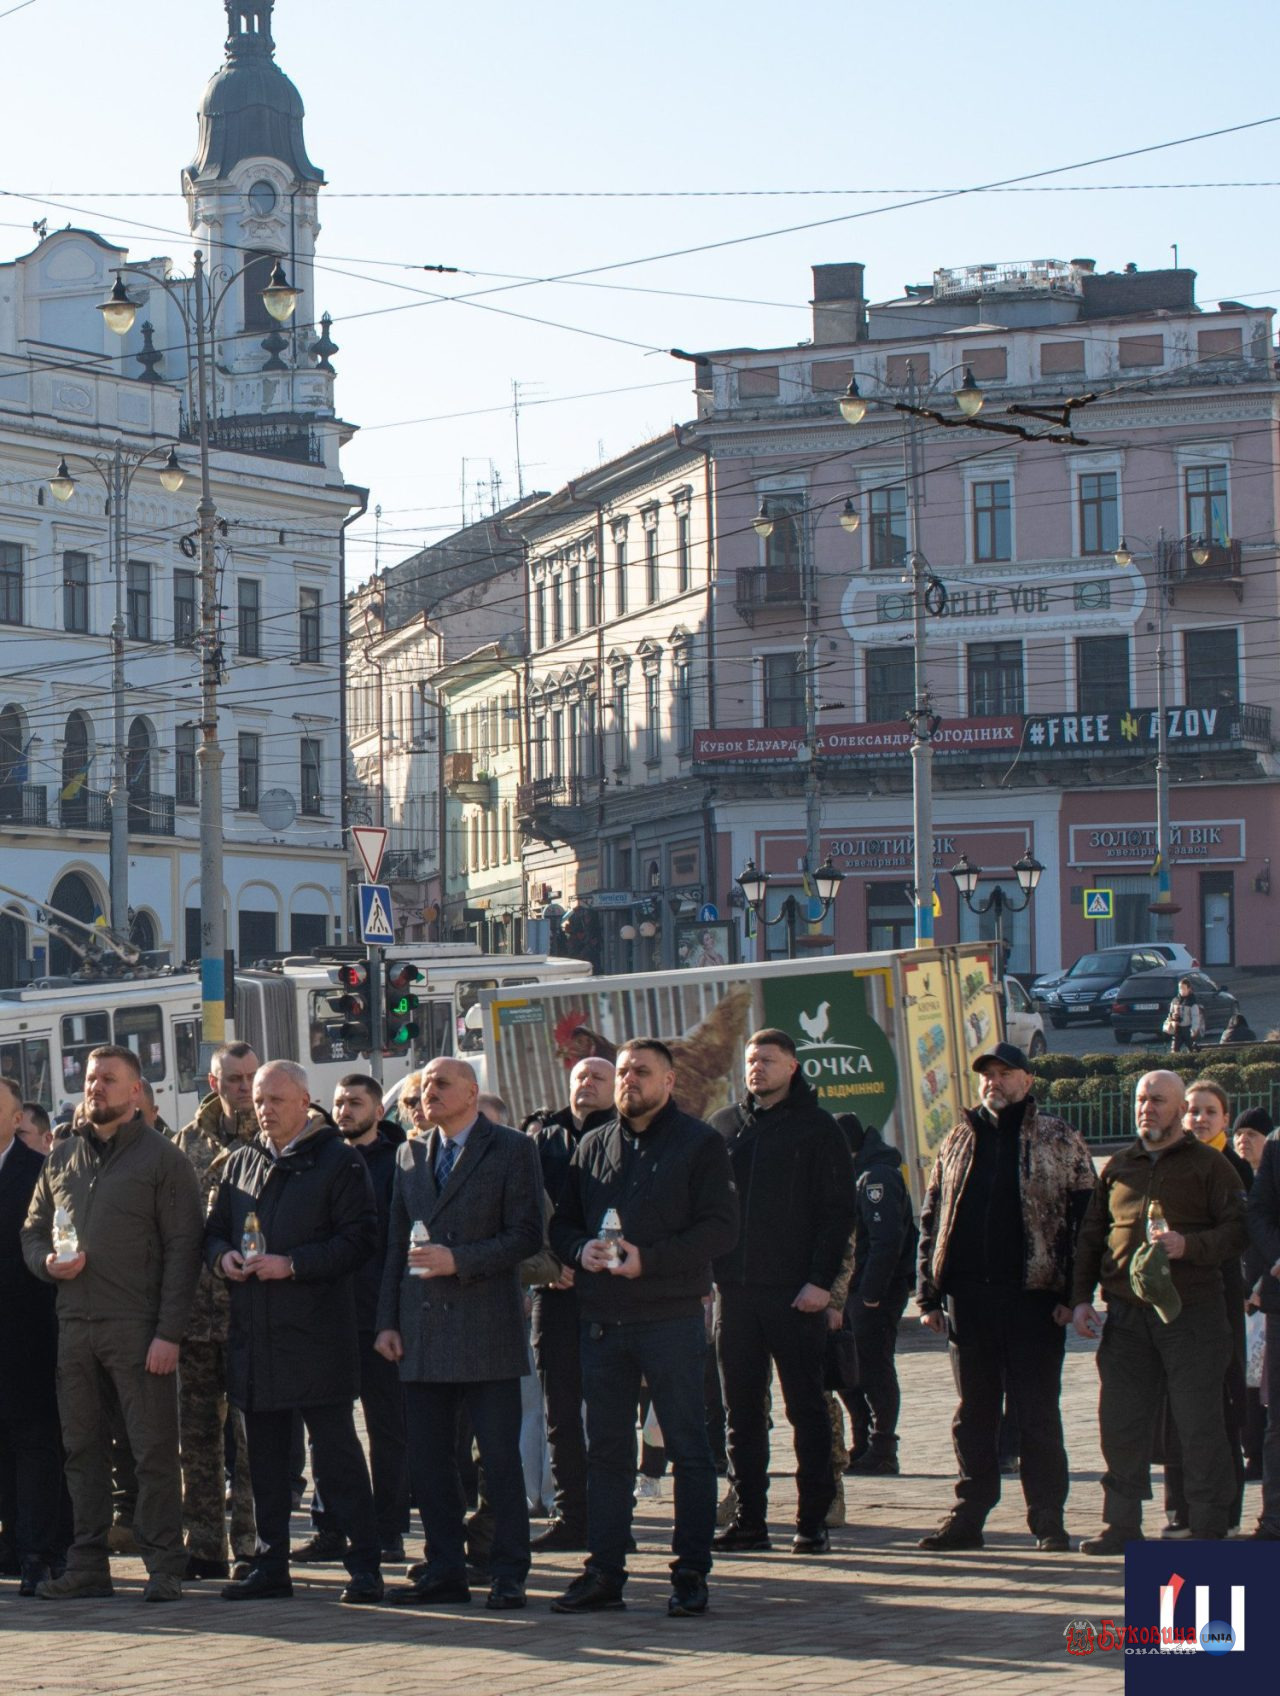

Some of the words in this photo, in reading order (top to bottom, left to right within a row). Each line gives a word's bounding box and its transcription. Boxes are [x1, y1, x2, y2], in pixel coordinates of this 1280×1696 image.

[1009, 586, 1049, 614] VUE
[928, 726, 1014, 743] ОГОДІНИХ
[1029, 714, 1110, 747] #FREE
[1150, 708, 1217, 739] AZOV
[1089, 826, 1182, 848] ЗОЛОТЙ
[1190, 827, 1221, 844] ВІК
[1175, 846, 1208, 855] завод
[802, 1055, 873, 1077] ОЧКА
[827, 1081, 886, 1098] ВІДМІННО!
